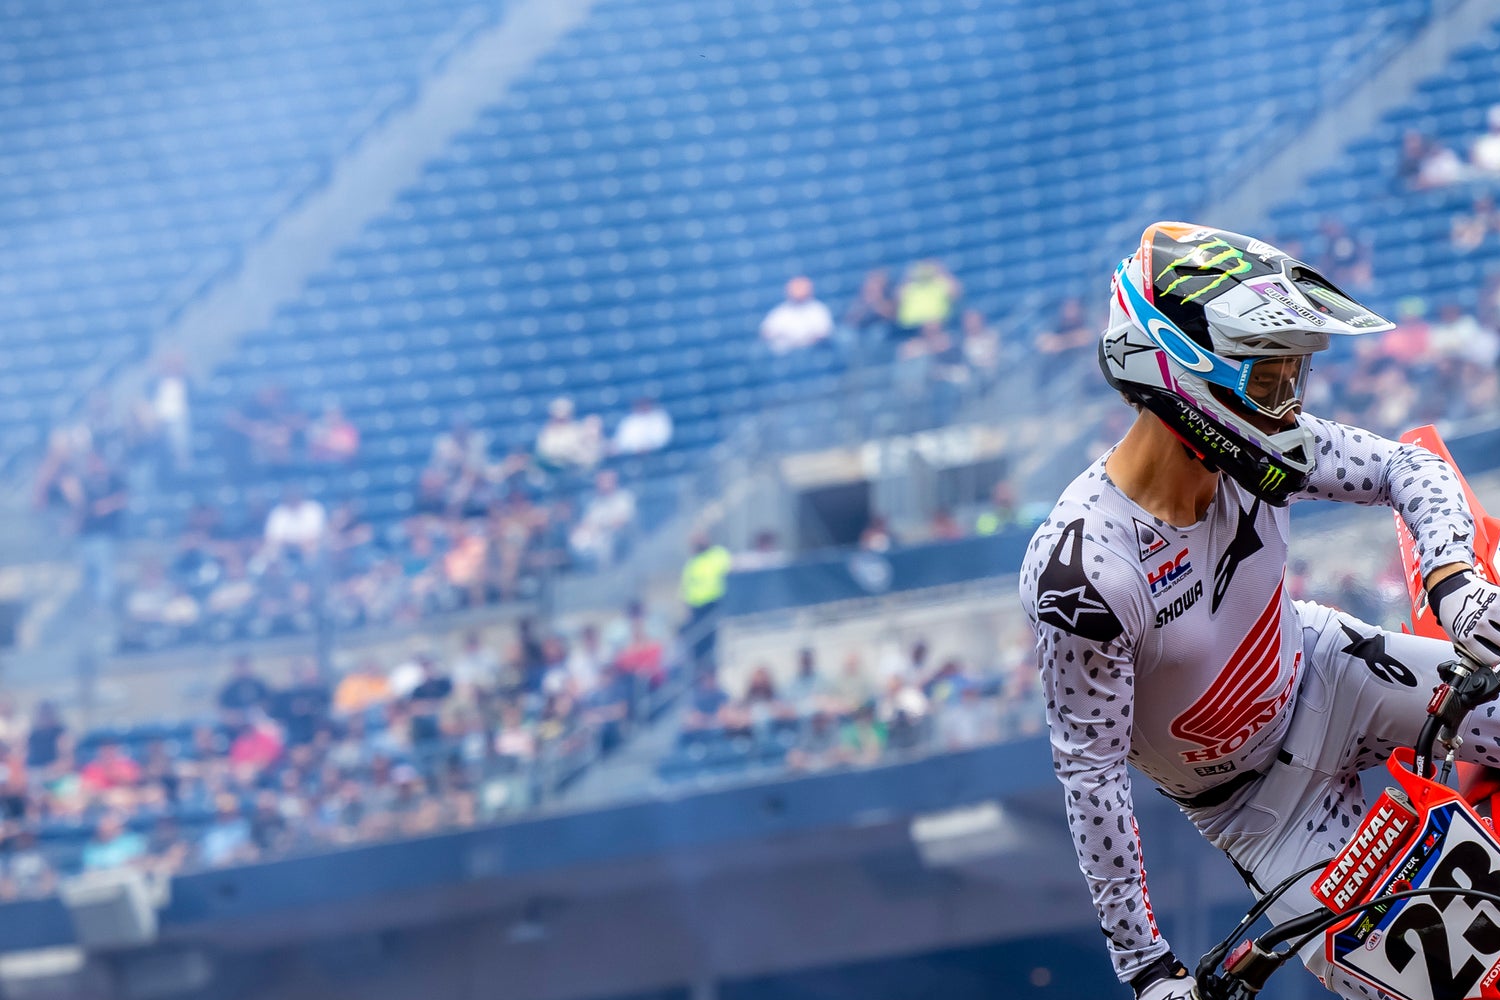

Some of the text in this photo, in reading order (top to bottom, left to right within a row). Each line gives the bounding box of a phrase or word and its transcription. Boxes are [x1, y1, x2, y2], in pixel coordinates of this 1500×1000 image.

[1264, 288, 1325, 326] apdesigns
[1238, 363, 1250, 391] OAKLEY
[1177, 400, 1241, 458] MONSTER
[1180, 414, 1225, 454] ENERGY
[1147, 547, 1191, 594] HRC
[1154, 579, 1203, 629] SHOWA
[1463, 592, 1498, 638] ASTARS
[1320, 807, 1394, 898] RENTHAL
[1333, 817, 1408, 909] RENTHAL
